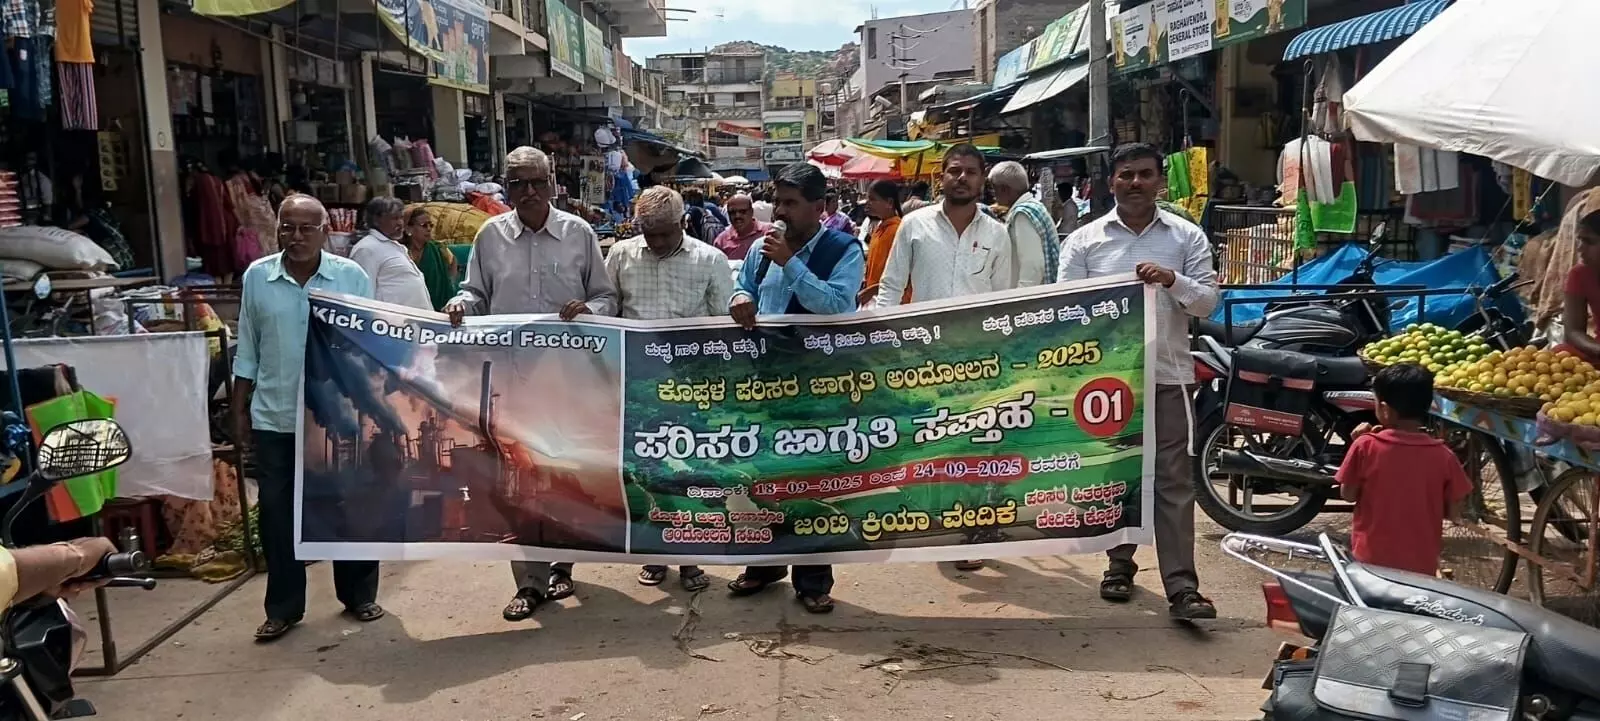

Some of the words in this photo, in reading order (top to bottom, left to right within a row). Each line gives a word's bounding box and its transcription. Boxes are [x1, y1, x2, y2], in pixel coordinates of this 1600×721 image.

[1170, 10, 1207, 31] RAGHAVENDRA
[1169, 29, 1191, 44] GENERAL
[1193, 23, 1209, 37] STORE
[1014, 309, 1054, 327] ಪರಿಸರ
[1058, 305, 1090, 325] ನಮ್ಮ
[313, 306, 364, 331] Kick
[371, 318, 413, 341] Out
[420, 327, 513, 347] Polluted
[520, 331, 607, 353] Factory
[870, 329, 901, 348] ನಮ್ಮ
[703, 340, 732, 360] ನಮ್ಮ
[658, 377, 726, 410] ಕೊಪ್ಪಳ
[735, 375, 798, 402] ಪರಿಸರ
[810, 370, 876, 403] ಜಾಗೃತಿ
[1038, 341, 1101, 370] 2025
[633, 422, 761, 459] ಪರಿಸರ
[774, 416, 897, 462] ಜಾಗೃತಿ
[913, 391, 1035, 443] ಸಪ್ತಾಹ
[1082, 389, 1123, 424] 01
[1025, 484, 1067, 506] ಪರಿಸರ
[794, 513, 850, 536] ಜಂಟಿ
[861, 506, 930, 541] ಕ್ರಿಯಾ
[943, 500, 1018, 530] ವೇದಿಕೆ
